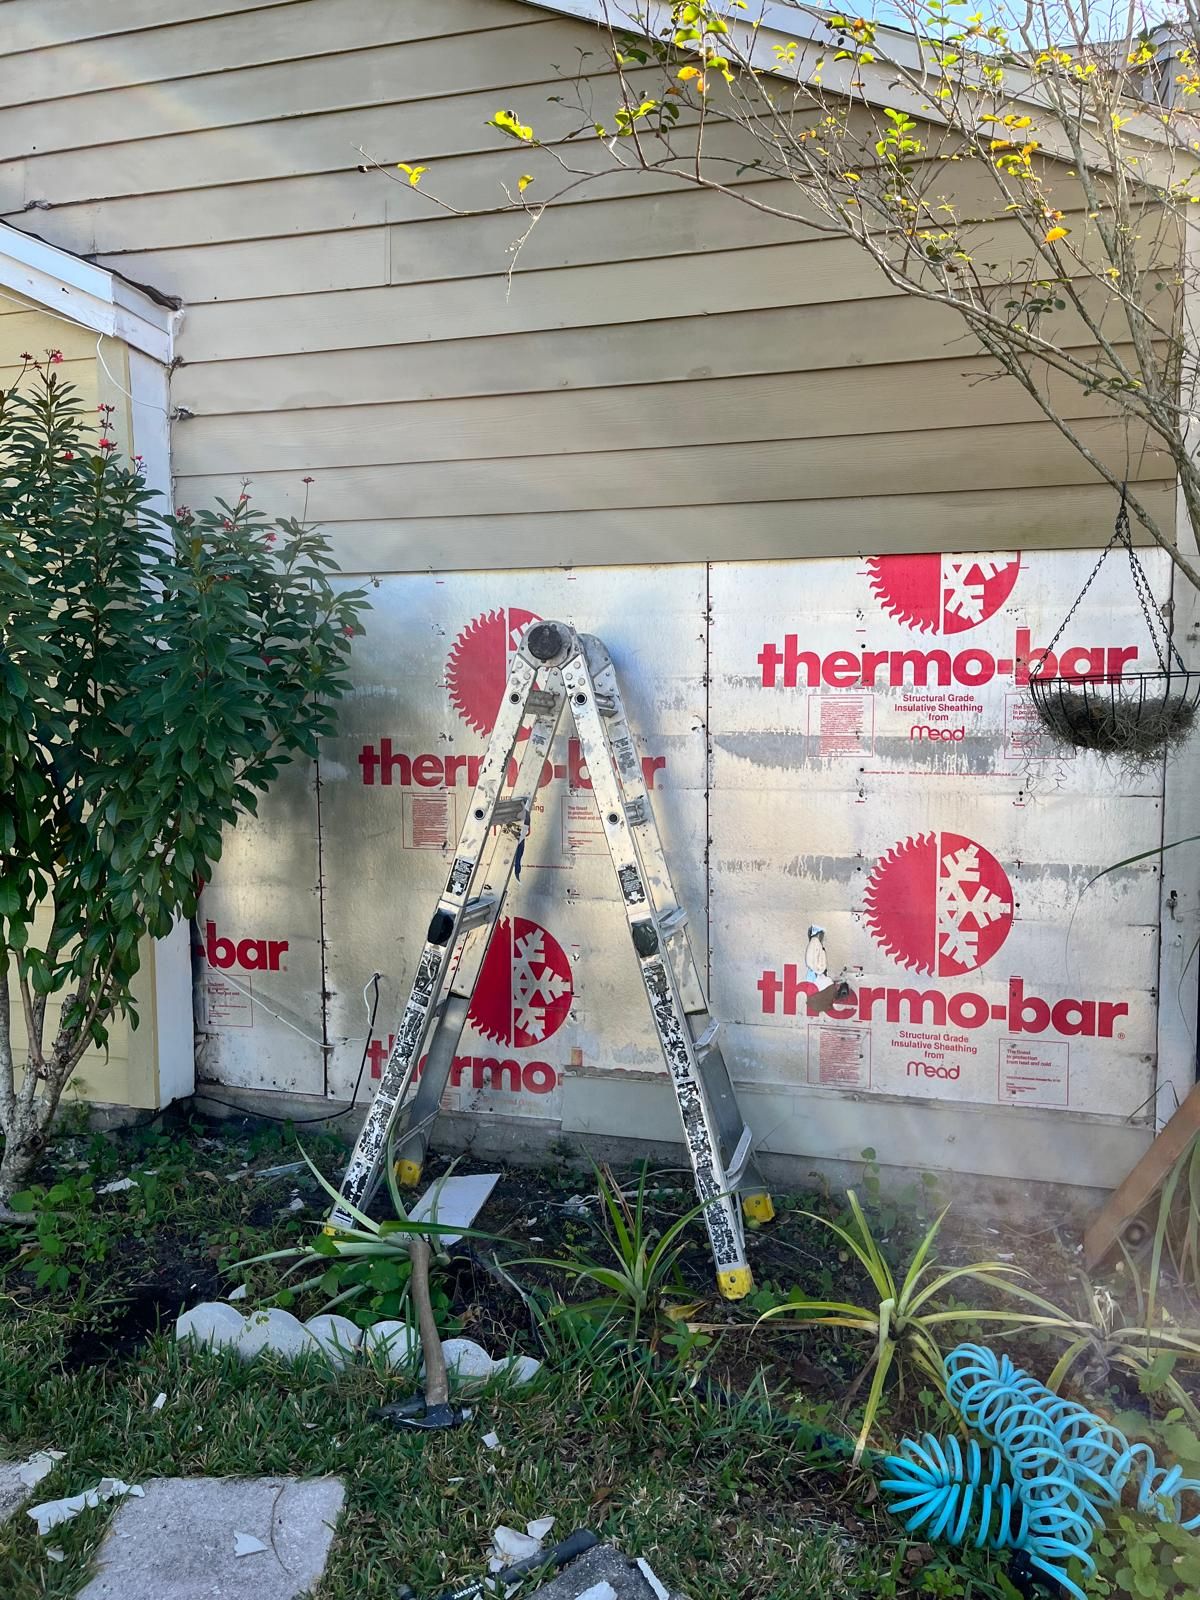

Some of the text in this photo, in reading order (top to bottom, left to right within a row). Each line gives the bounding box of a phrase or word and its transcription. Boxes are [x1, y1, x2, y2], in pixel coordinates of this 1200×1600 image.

[757, 630, 1138, 687] thermo-bar
[903, 694, 975, 702] Structural Grade
[895, 703, 983, 713] Insulative Sheathing
[928, 713, 949, 721] from
[899, 1030, 969, 1043] Structural Grade
[891, 1039, 977, 1054] Insulative Sheathing
[924, 1050, 944, 1059] from
